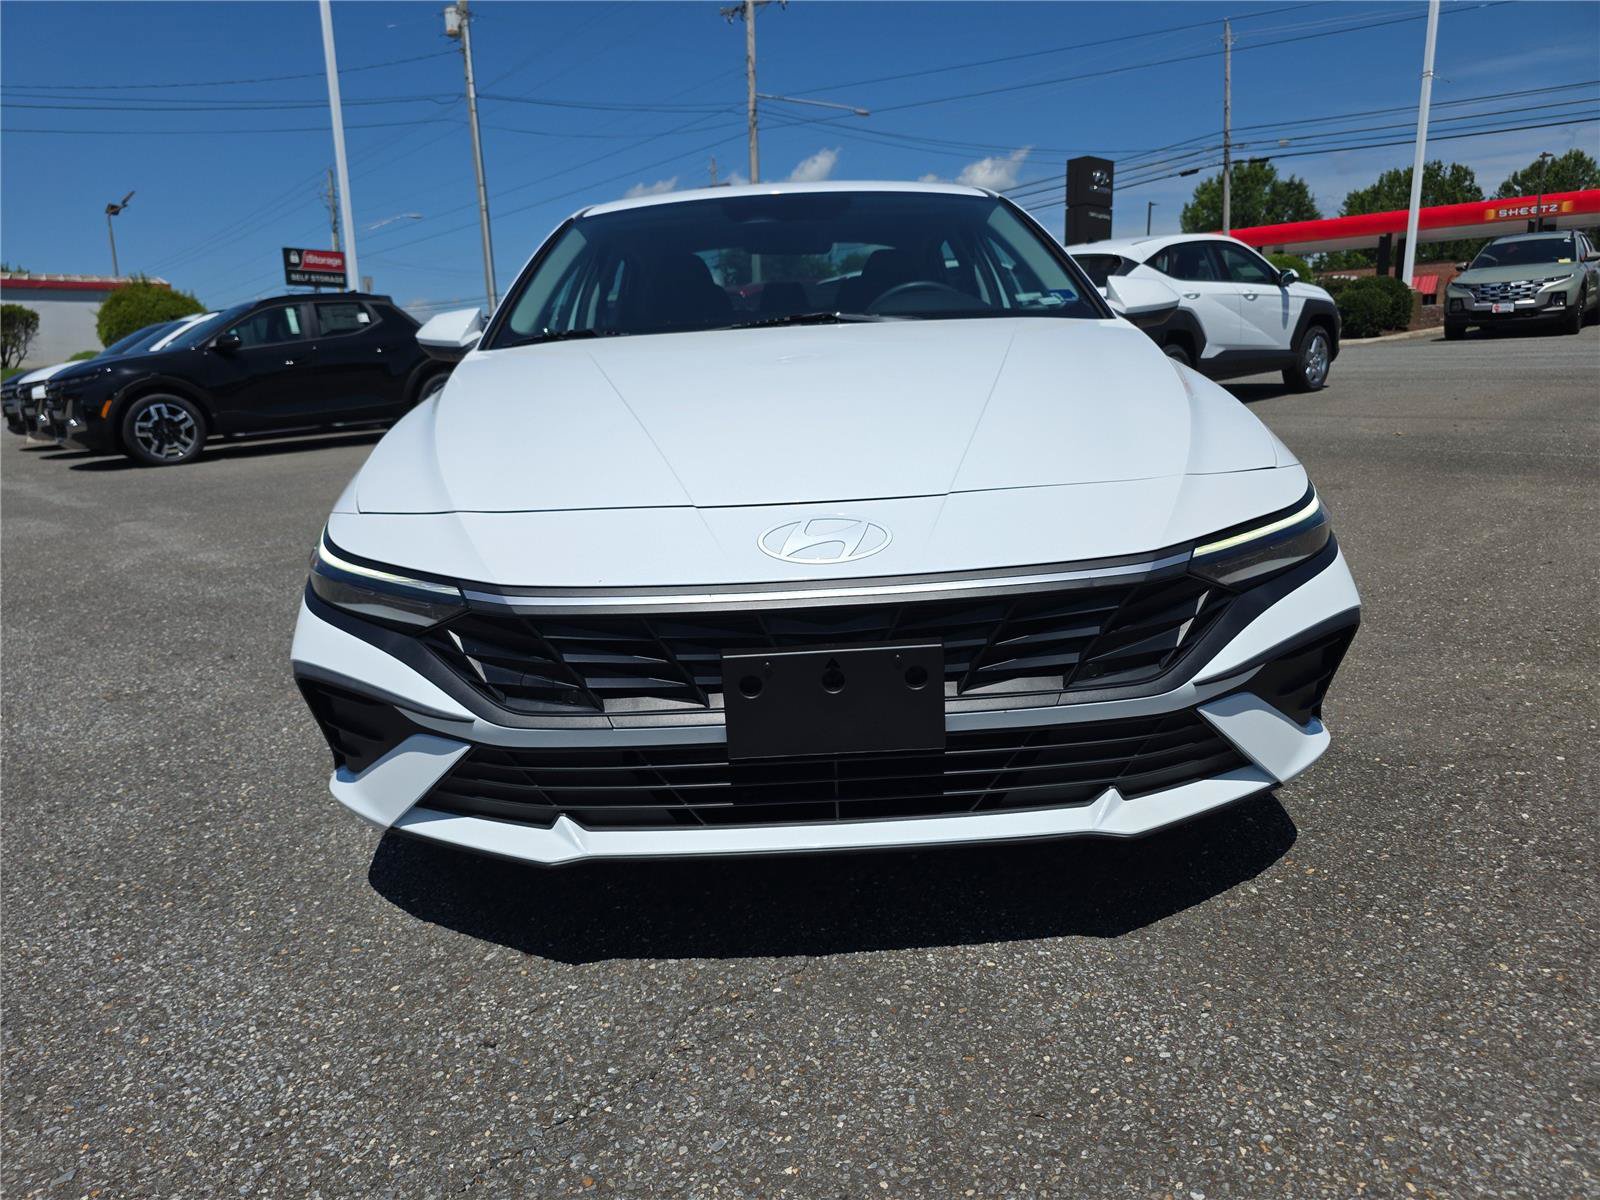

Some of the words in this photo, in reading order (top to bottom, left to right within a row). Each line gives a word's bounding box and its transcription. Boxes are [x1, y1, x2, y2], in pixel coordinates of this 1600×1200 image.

[1498, 204, 1558, 218] SHEETZ
[291, 273, 309, 281] SELF
[310, 274, 344, 283] STORAGE
